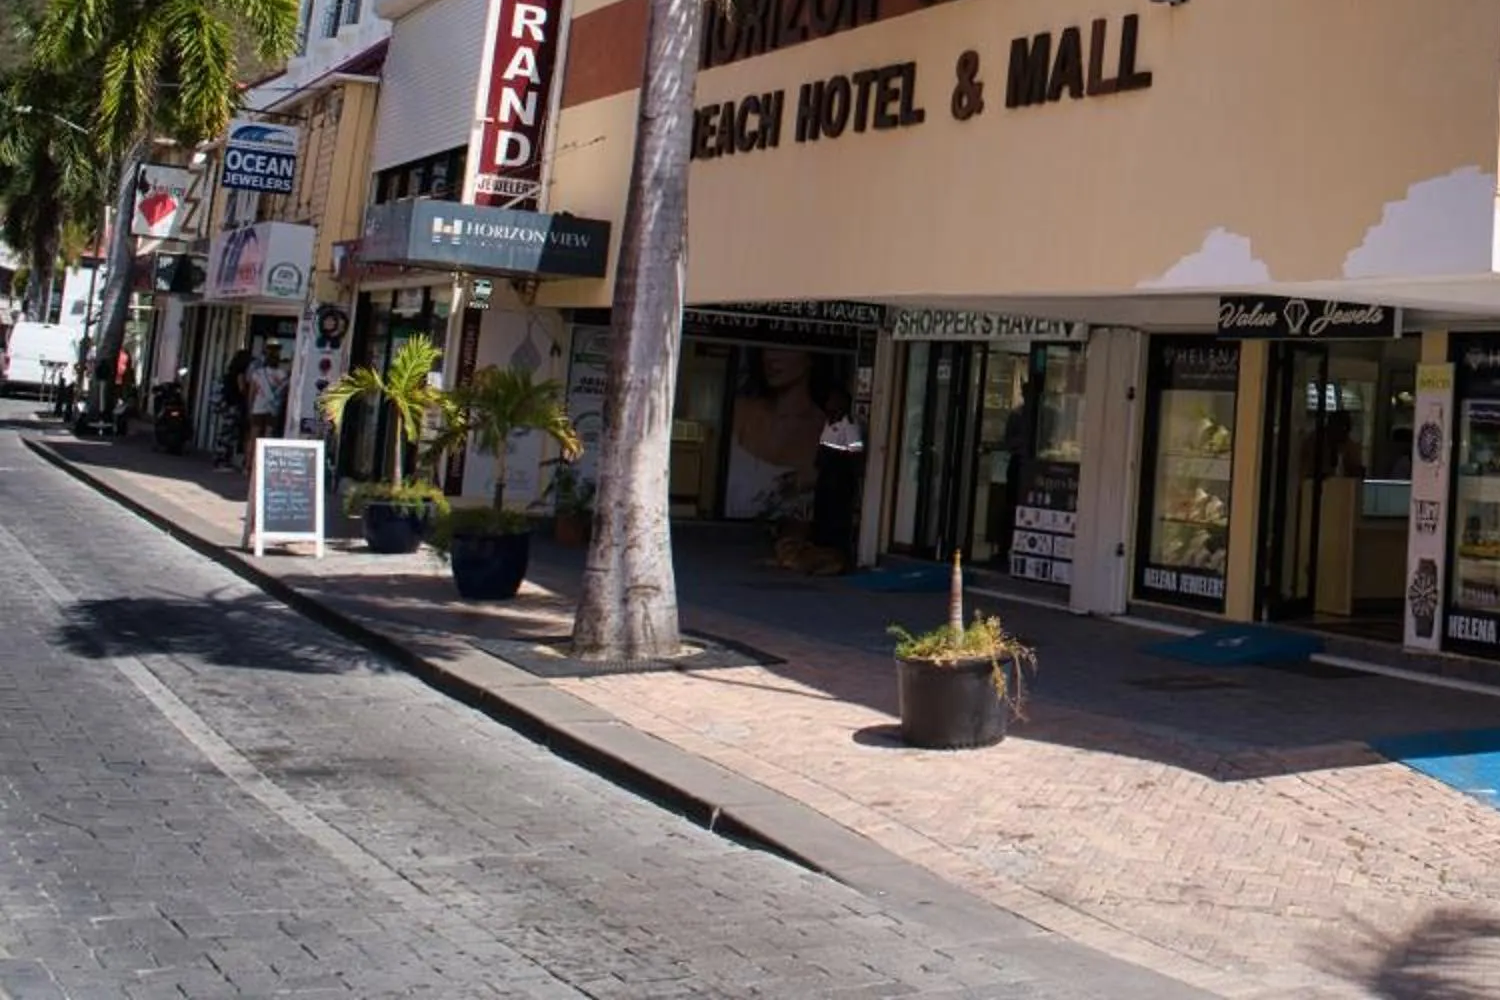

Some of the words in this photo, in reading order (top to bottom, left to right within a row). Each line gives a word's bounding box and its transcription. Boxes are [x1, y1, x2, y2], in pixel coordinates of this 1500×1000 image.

[690, 89, 784, 162] EACH
[795, 61, 925, 144] HOTEL
[950, 50, 985, 121] &
[1005, 13, 1153, 109] MALL
[226, 150, 293, 177] OCEAN
[224, 172, 291, 191] JEWELERS
[466, 221, 547, 244] HORIZON
[550, 231, 592, 248] VIEW
[823, 302, 880, 322] HAVEN
[997, 313, 1060, 336] HAVEN
[1219, 302, 1278, 328] Value
[1308, 300, 1384, 336] Jewels
[1143, 567, 1178, 592] HELENA
[1448, 614, 1497, 644] HELENA
